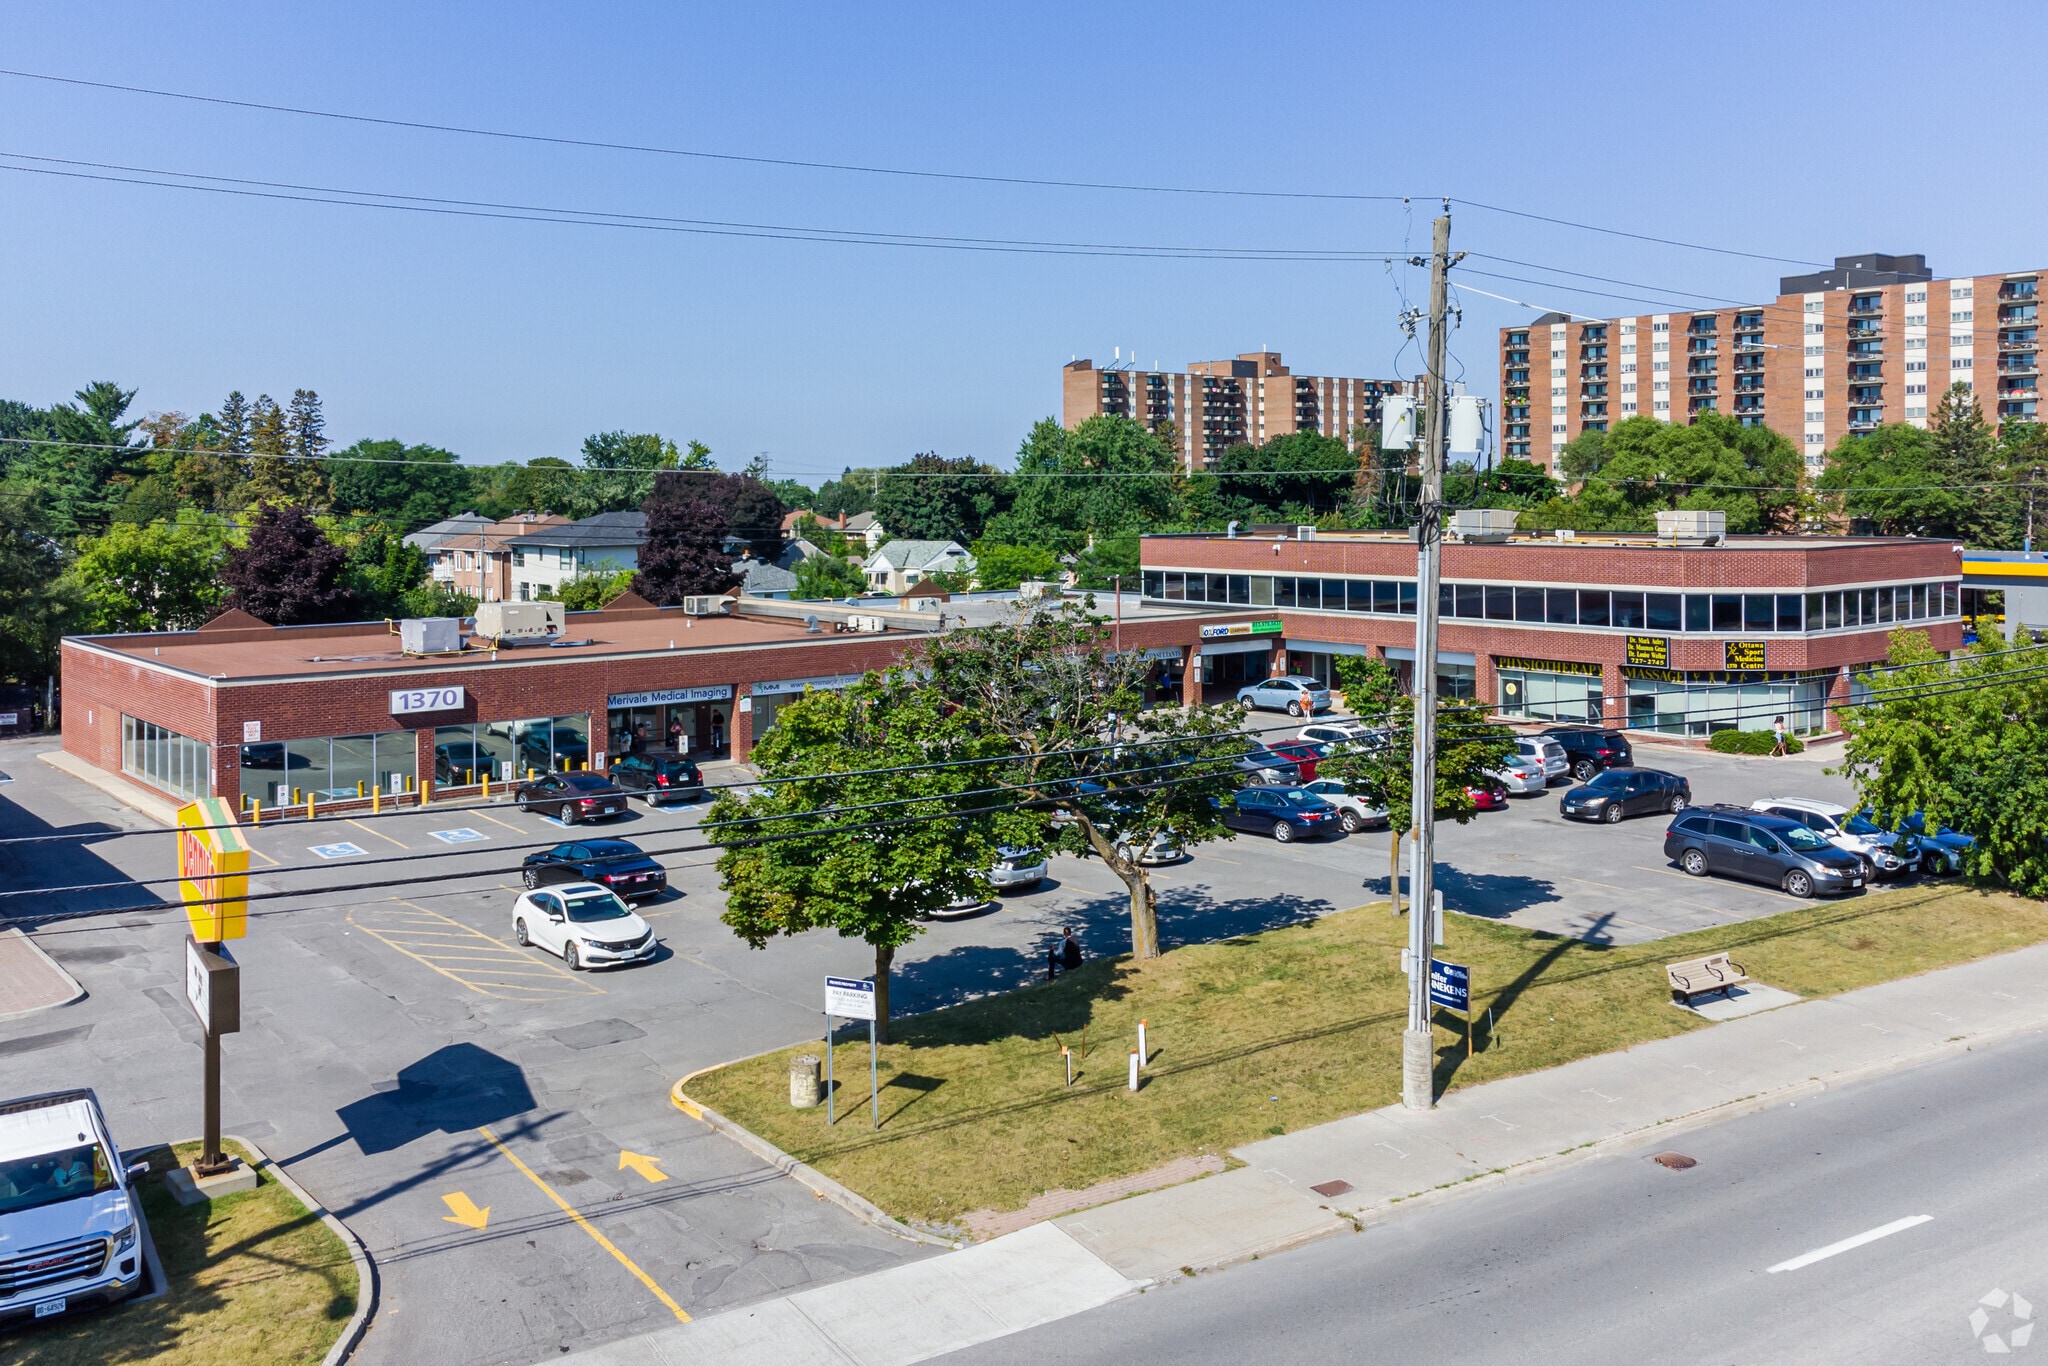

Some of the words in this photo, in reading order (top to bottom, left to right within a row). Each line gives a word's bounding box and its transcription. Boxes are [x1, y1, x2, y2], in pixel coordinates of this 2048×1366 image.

[1630, 657, 1665, 665] 727-2745
[1744, 648, 1764, 657] Sport
[1499, 657, 1603, 677] PHYSIOTHERAPY
[1625, 667, 1685, 683] MASSAGE
[398, 689, 458, 710] 1370
[607, 695, 648, 706] Merivale
[651, 690, 688, 702] Medical
[691, 688, 728, 699] Imaging
[843, 991, 868, 1000] PARKING
[27, 1254, 74, 1272] GMC
